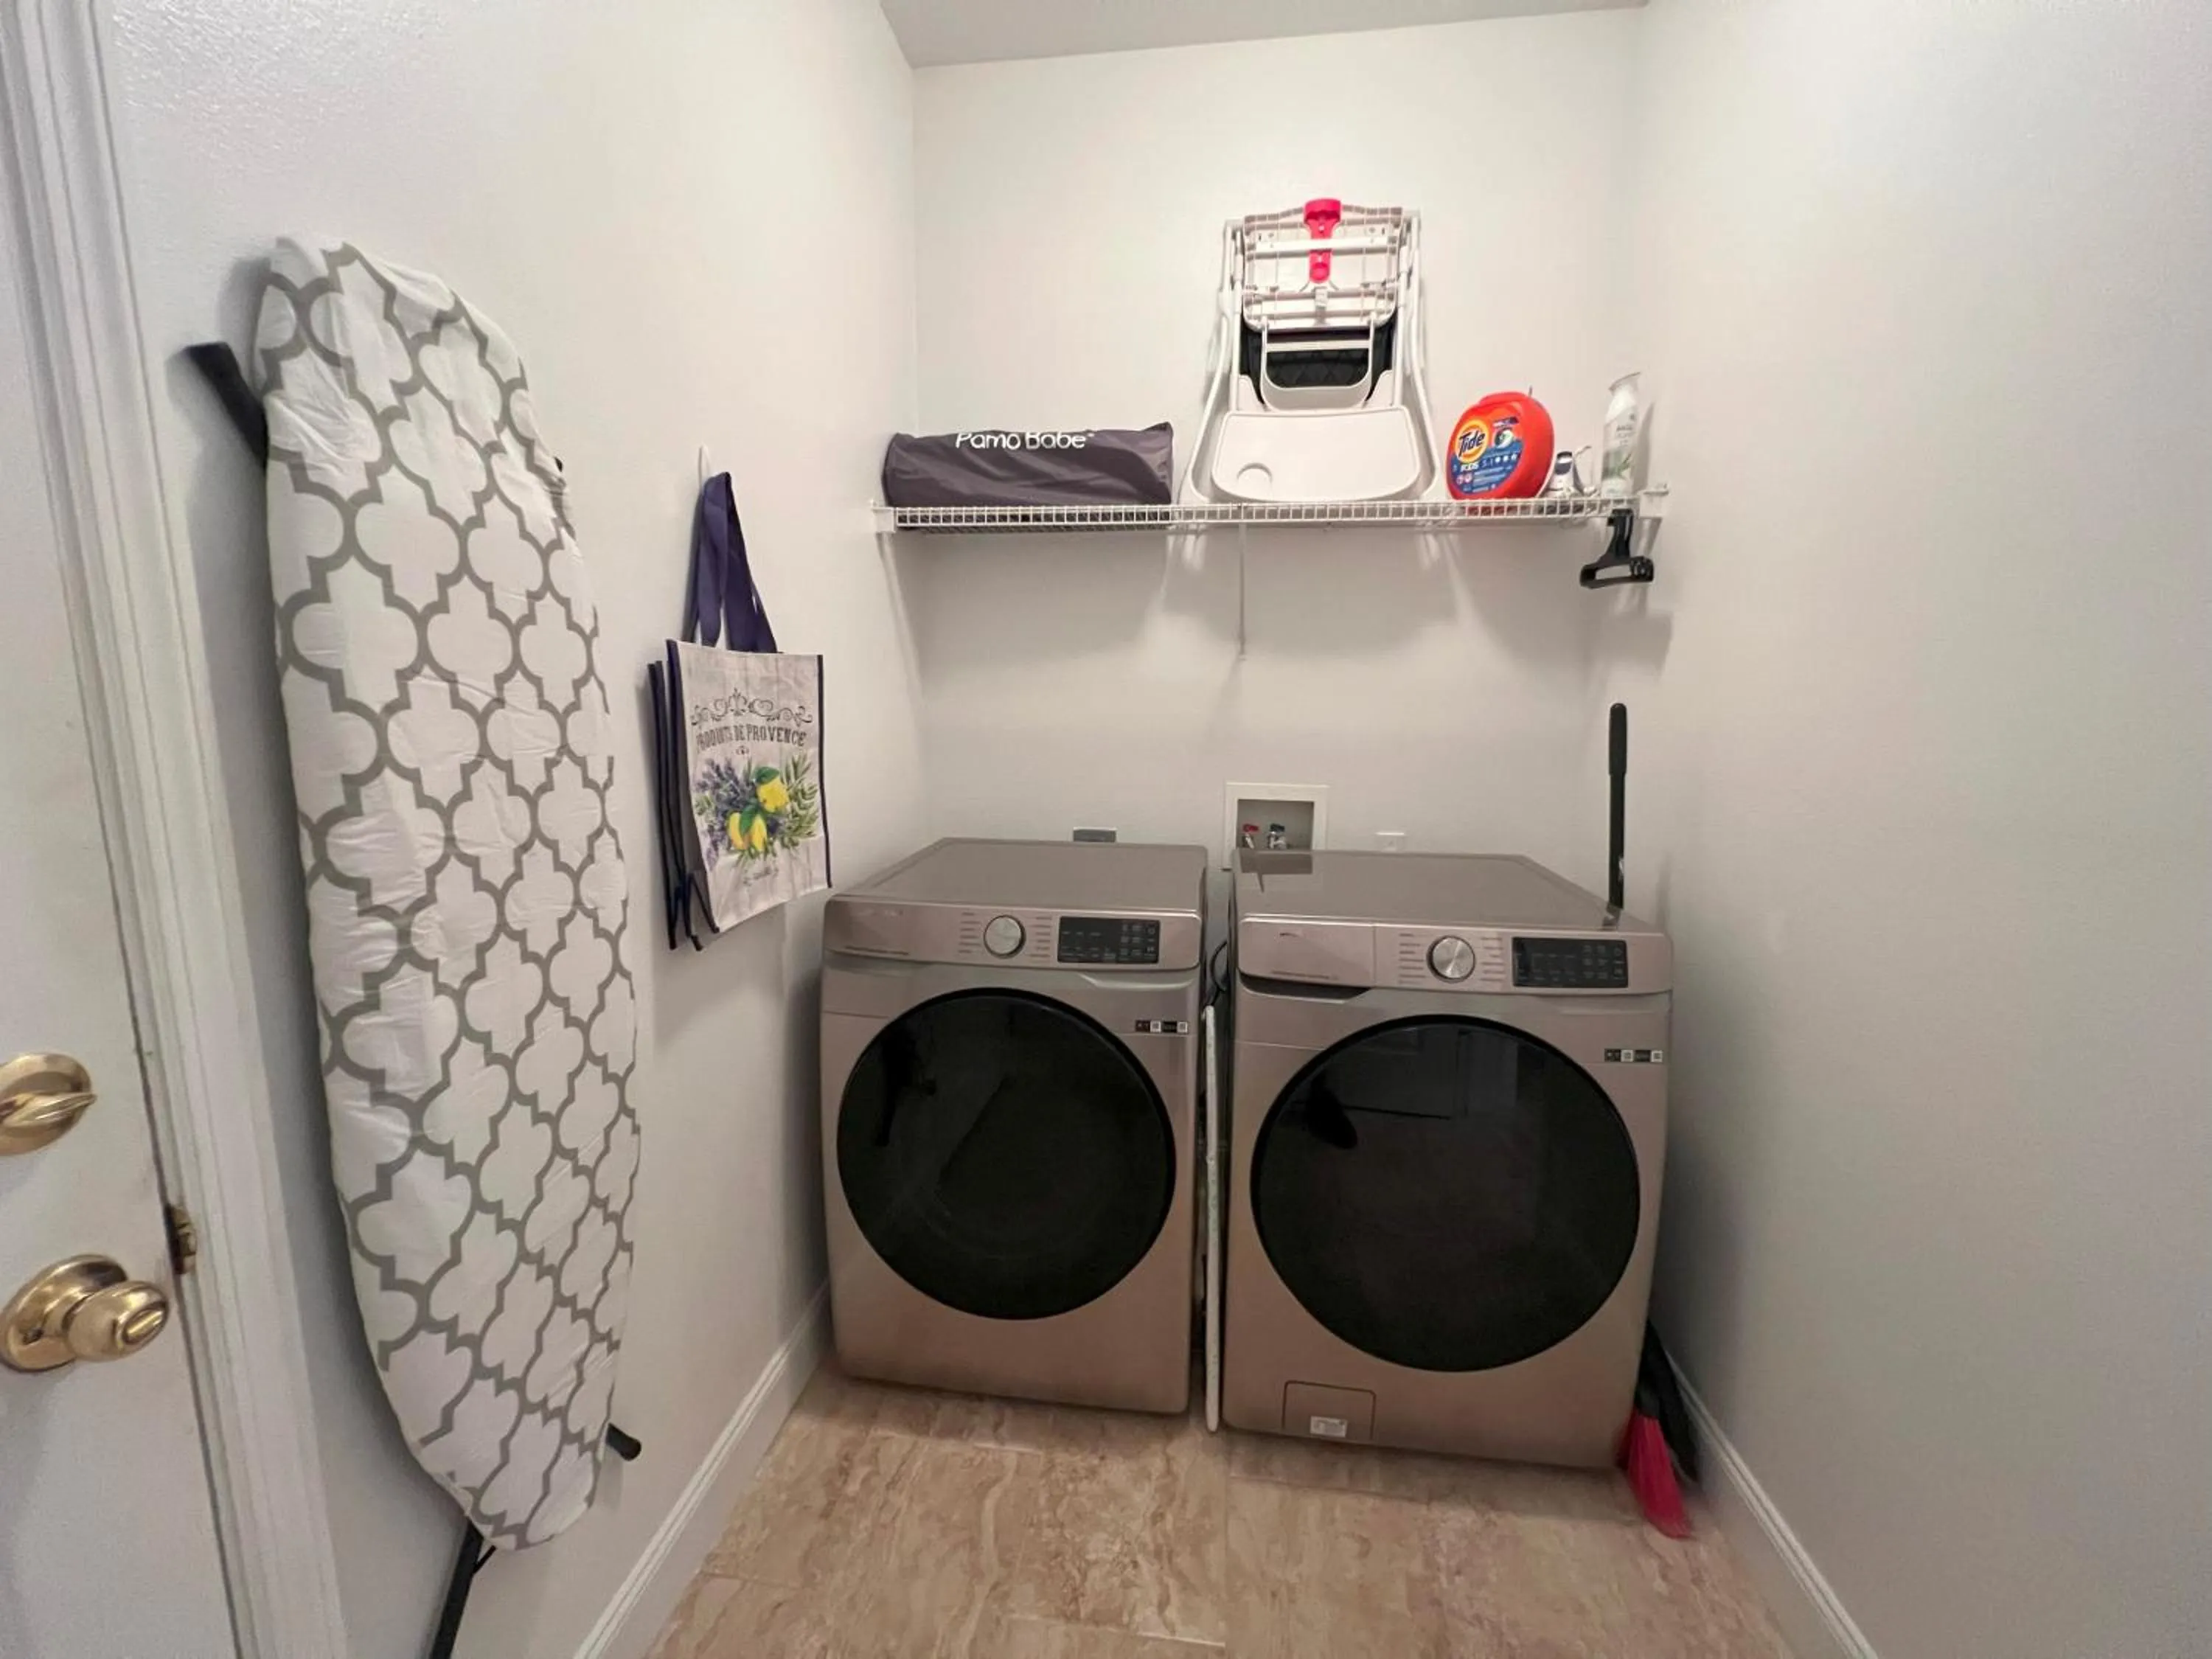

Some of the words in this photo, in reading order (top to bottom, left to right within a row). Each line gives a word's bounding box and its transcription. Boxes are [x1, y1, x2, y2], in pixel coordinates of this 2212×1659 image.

[956, 432, 1020, 450] Pamo
[1025, 431, 1085, 449] Babe
[1459, 430, 1485, 457] Tide
[746, 723, 807, 746] PROVENCE
